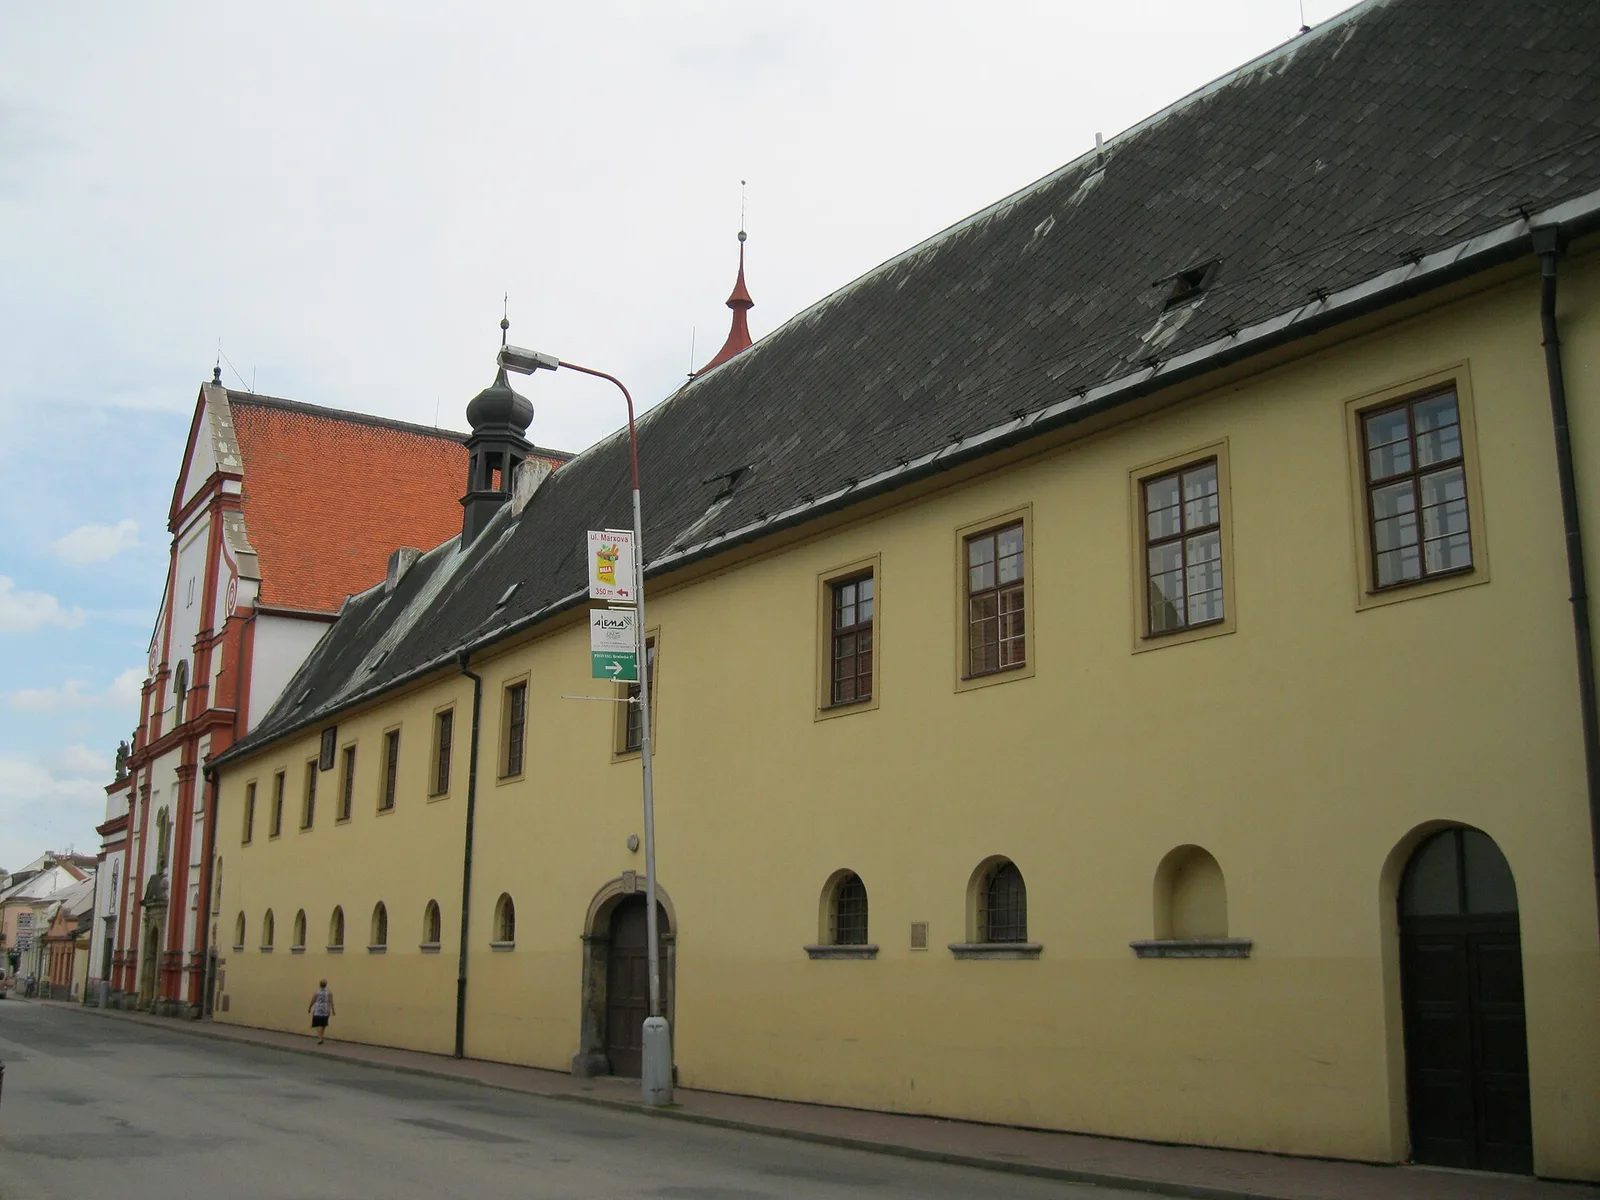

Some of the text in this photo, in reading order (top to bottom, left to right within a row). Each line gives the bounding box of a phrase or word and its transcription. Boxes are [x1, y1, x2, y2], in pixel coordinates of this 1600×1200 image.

[590, 533, 629, 543] ul. Marxova
[595, 587, 607, 595] 350
